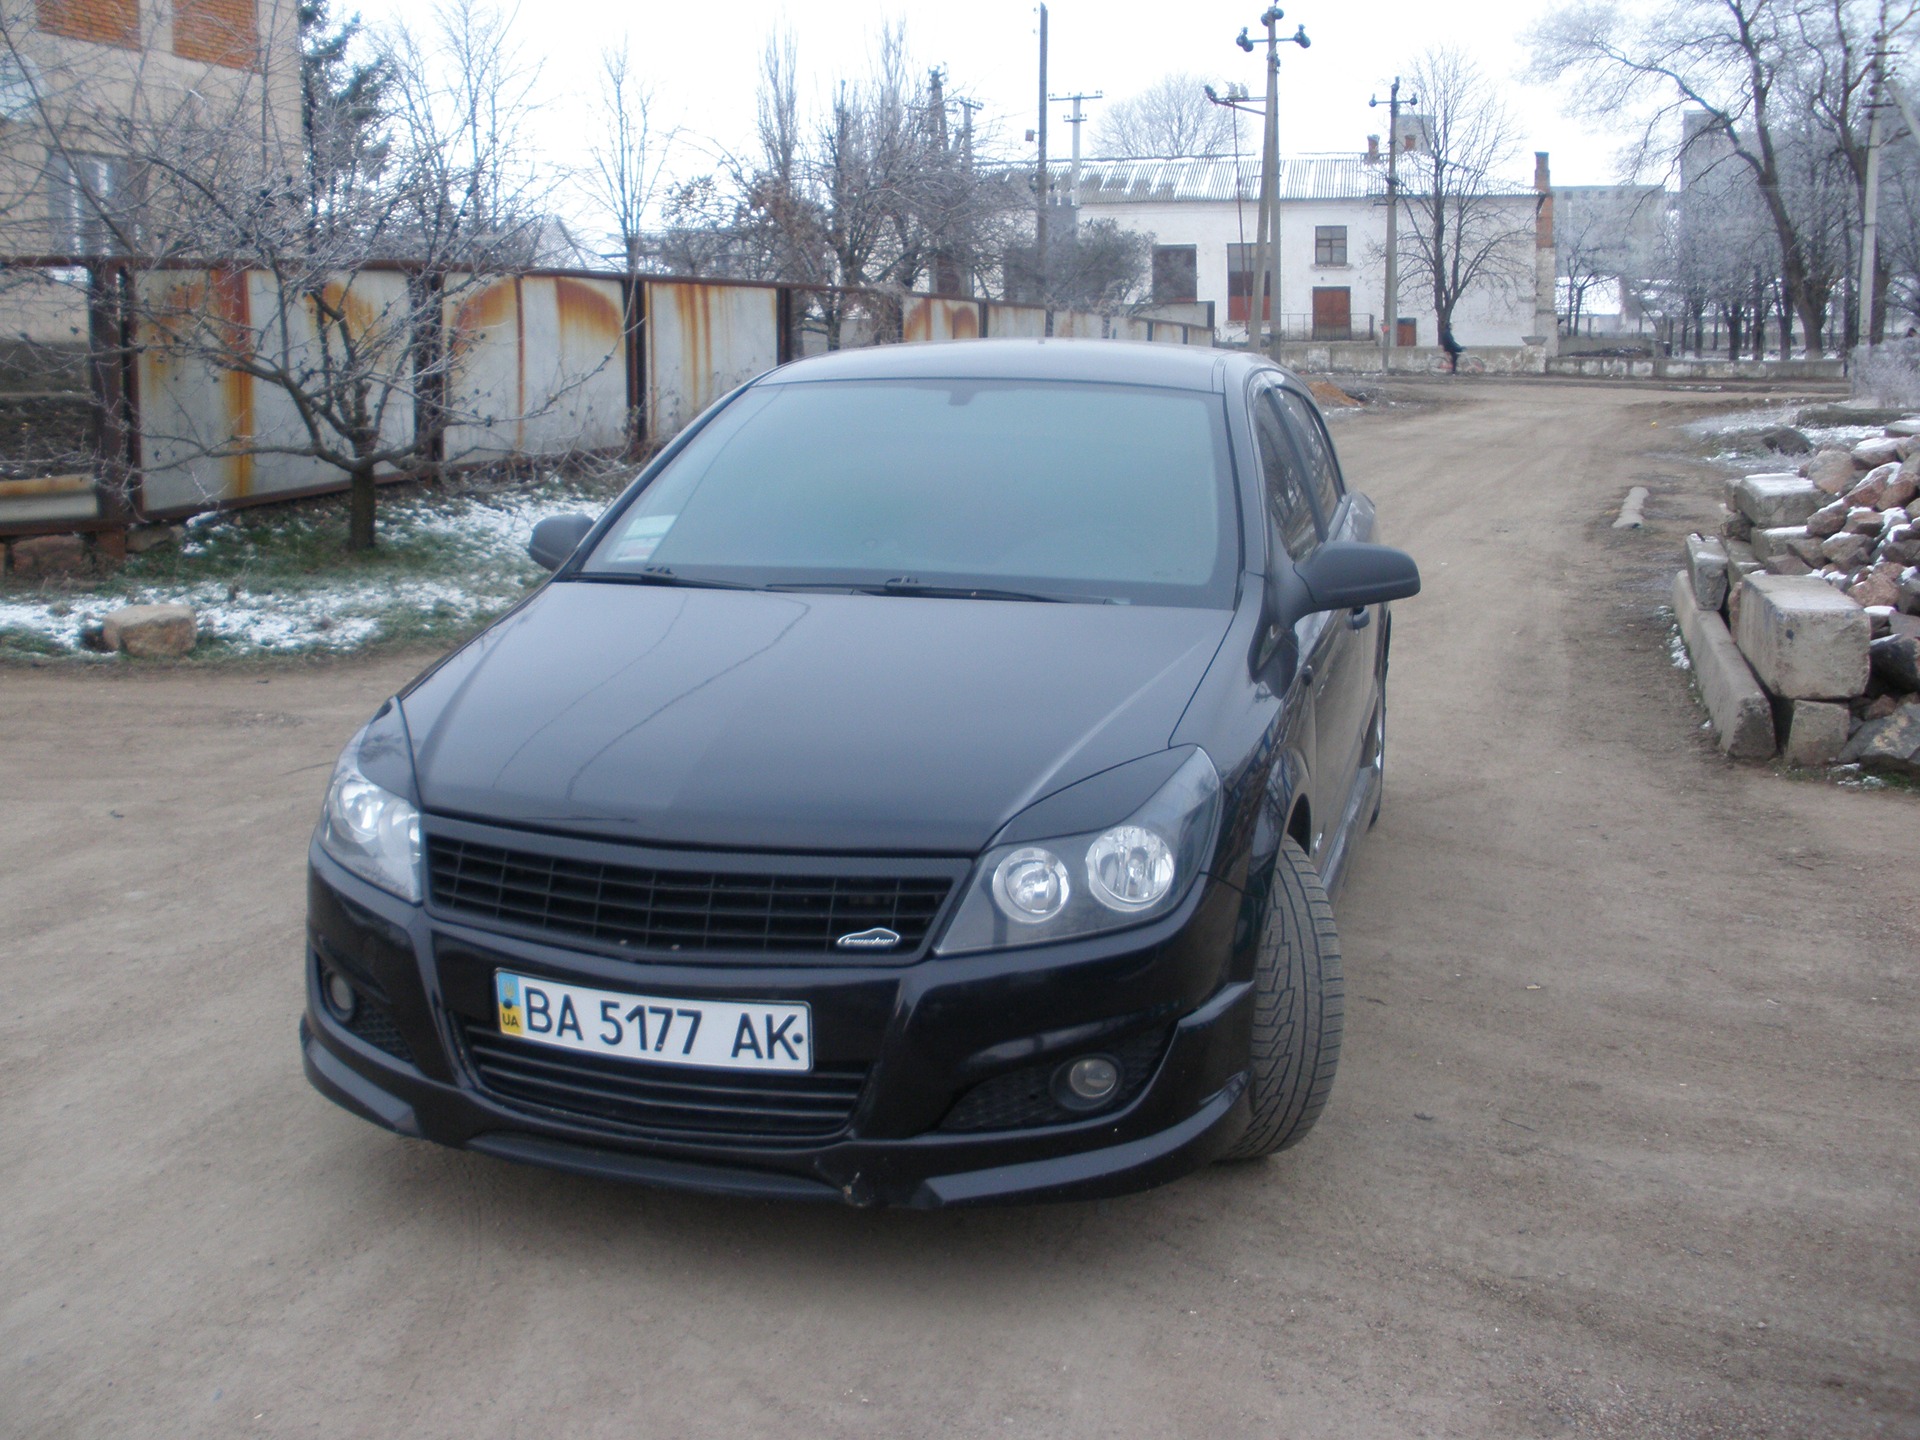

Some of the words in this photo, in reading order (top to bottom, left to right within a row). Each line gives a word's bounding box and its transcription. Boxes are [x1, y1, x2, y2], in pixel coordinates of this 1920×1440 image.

[502, 1013, 520, 1028] UA
[600, 1000, 703, 1055] 5177
[731, 1013, 800, 1060] AK
